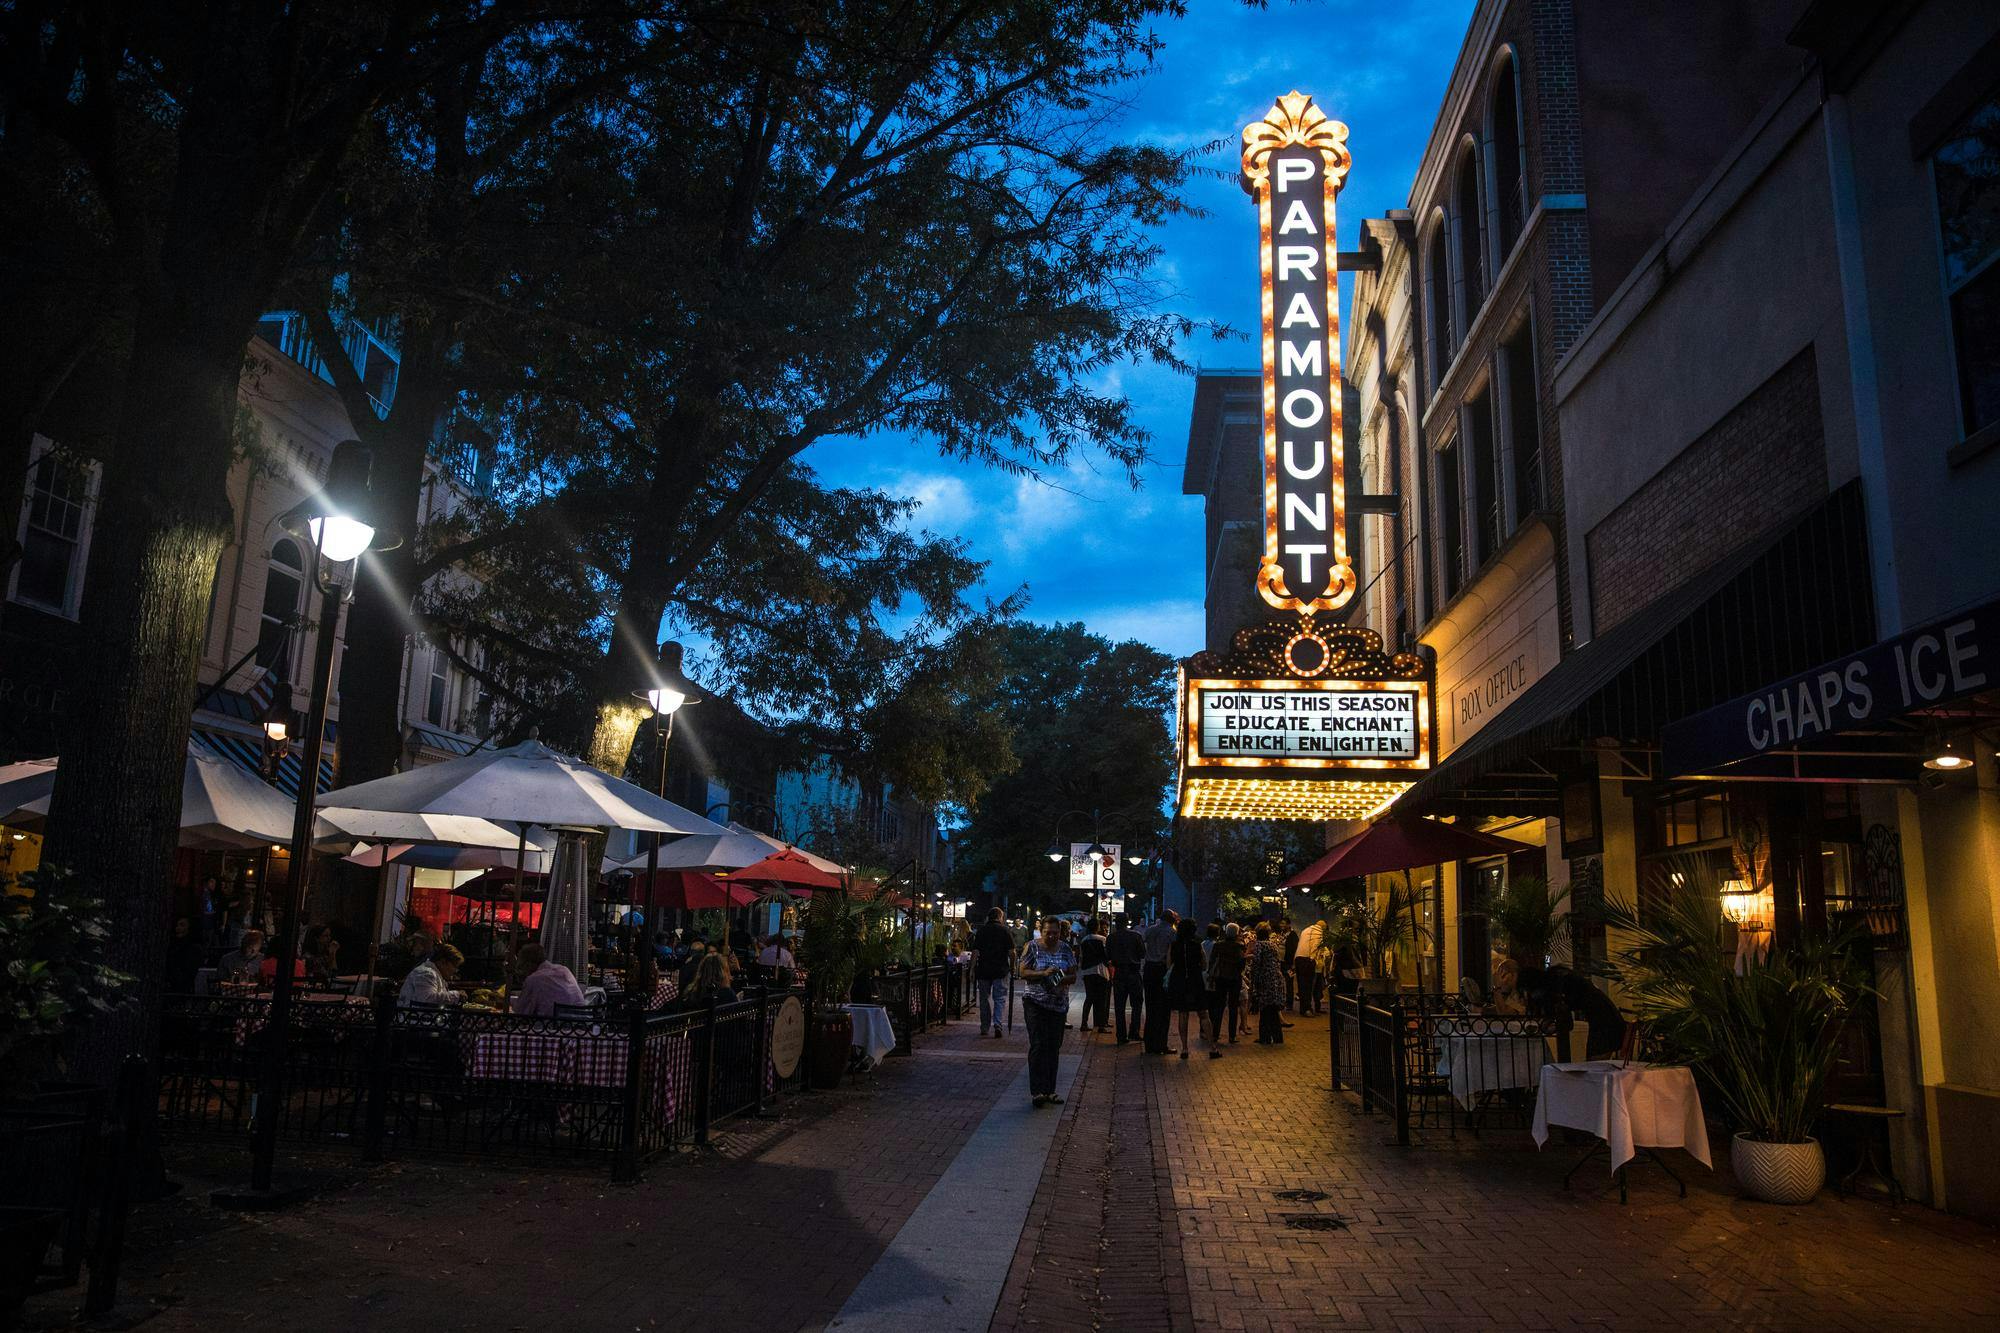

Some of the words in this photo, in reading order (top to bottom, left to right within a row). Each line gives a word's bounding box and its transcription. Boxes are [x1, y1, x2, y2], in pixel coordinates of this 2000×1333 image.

[1277, 157, 1328, 584] PARAMOUNT
[1210, 695, 1252, 710] JOIN
[1261, 696, 1285, 710] US
[1290, 696, 1331, 711] THIS
[1338, 697, 1409, 711] SEASON
[1460, 686, 1481, 725] BOX
[1486, 654, 1526, 708] OFFICE
[1746, 660, 1873, 750] CHAPS
[1894, 619, 1987, 707] ICE
[1218, 735, 1291, 752] ENRICH.
[1298, 736, 1409, 753] ENLIGHTEN.
[1225, 716, 1316, 732] EDUCATE.
[1321, 717, 1409, 732] ENCHANT.
